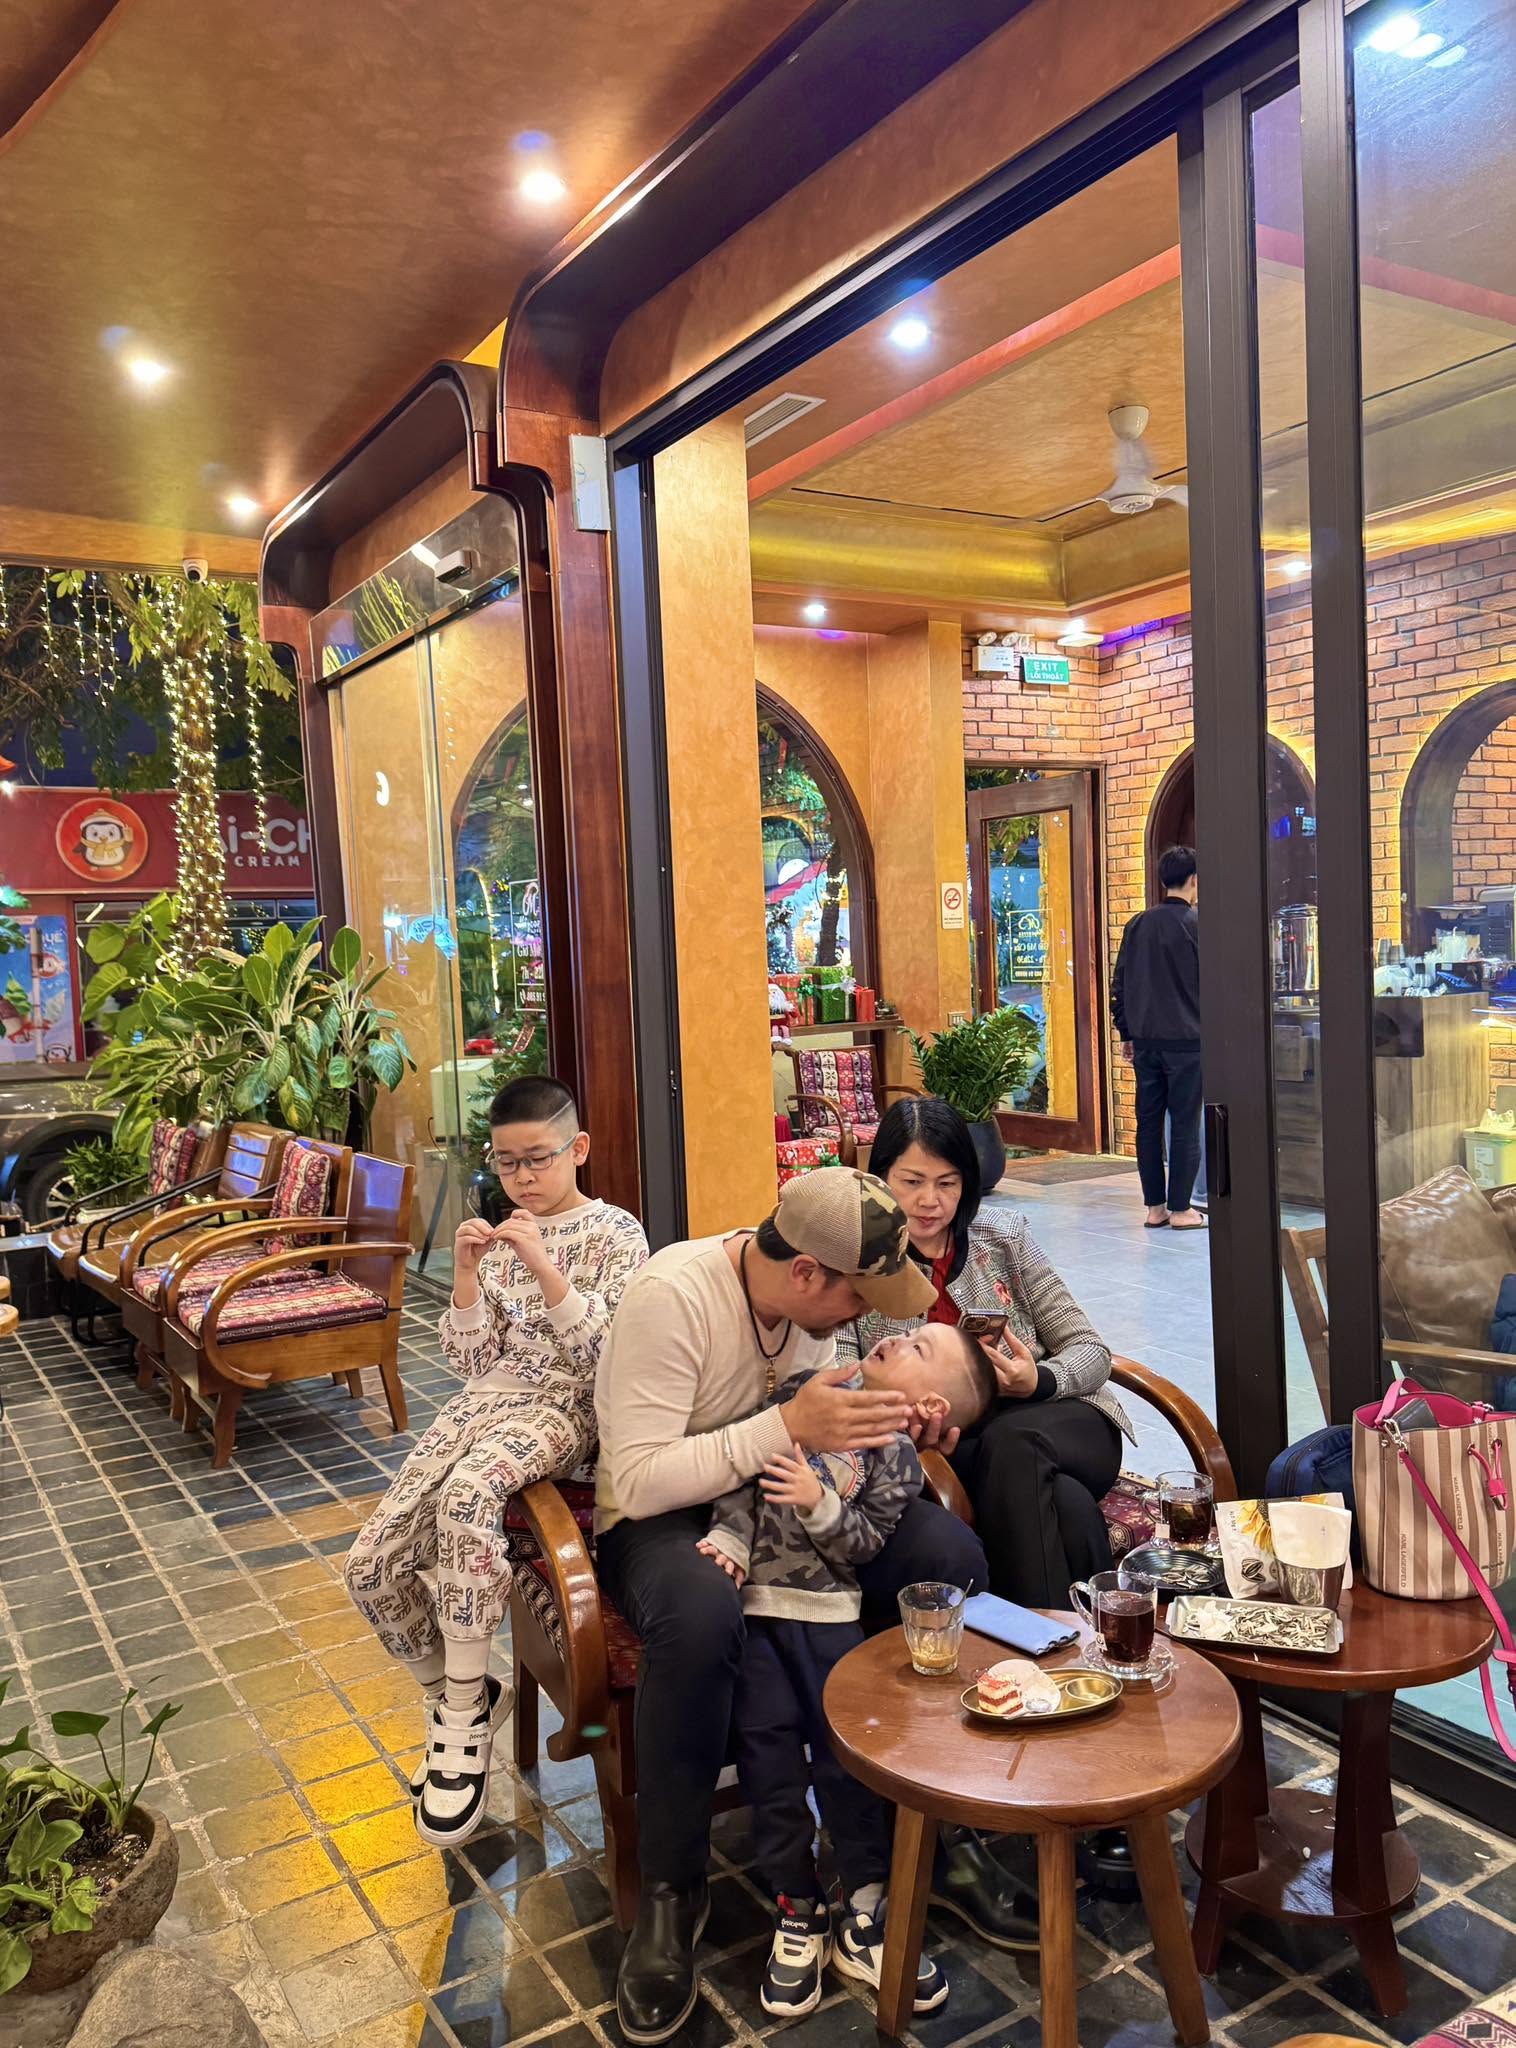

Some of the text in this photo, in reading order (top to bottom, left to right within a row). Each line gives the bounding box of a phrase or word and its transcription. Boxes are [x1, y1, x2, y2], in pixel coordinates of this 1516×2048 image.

[1033, 661, 1058, 672] EXIT
[1041, 672, 1065, 681] THOÁT
[233, 855, 301, 868] CREAM
[1455, 1494, 1464, 1531] LAGERFELD
